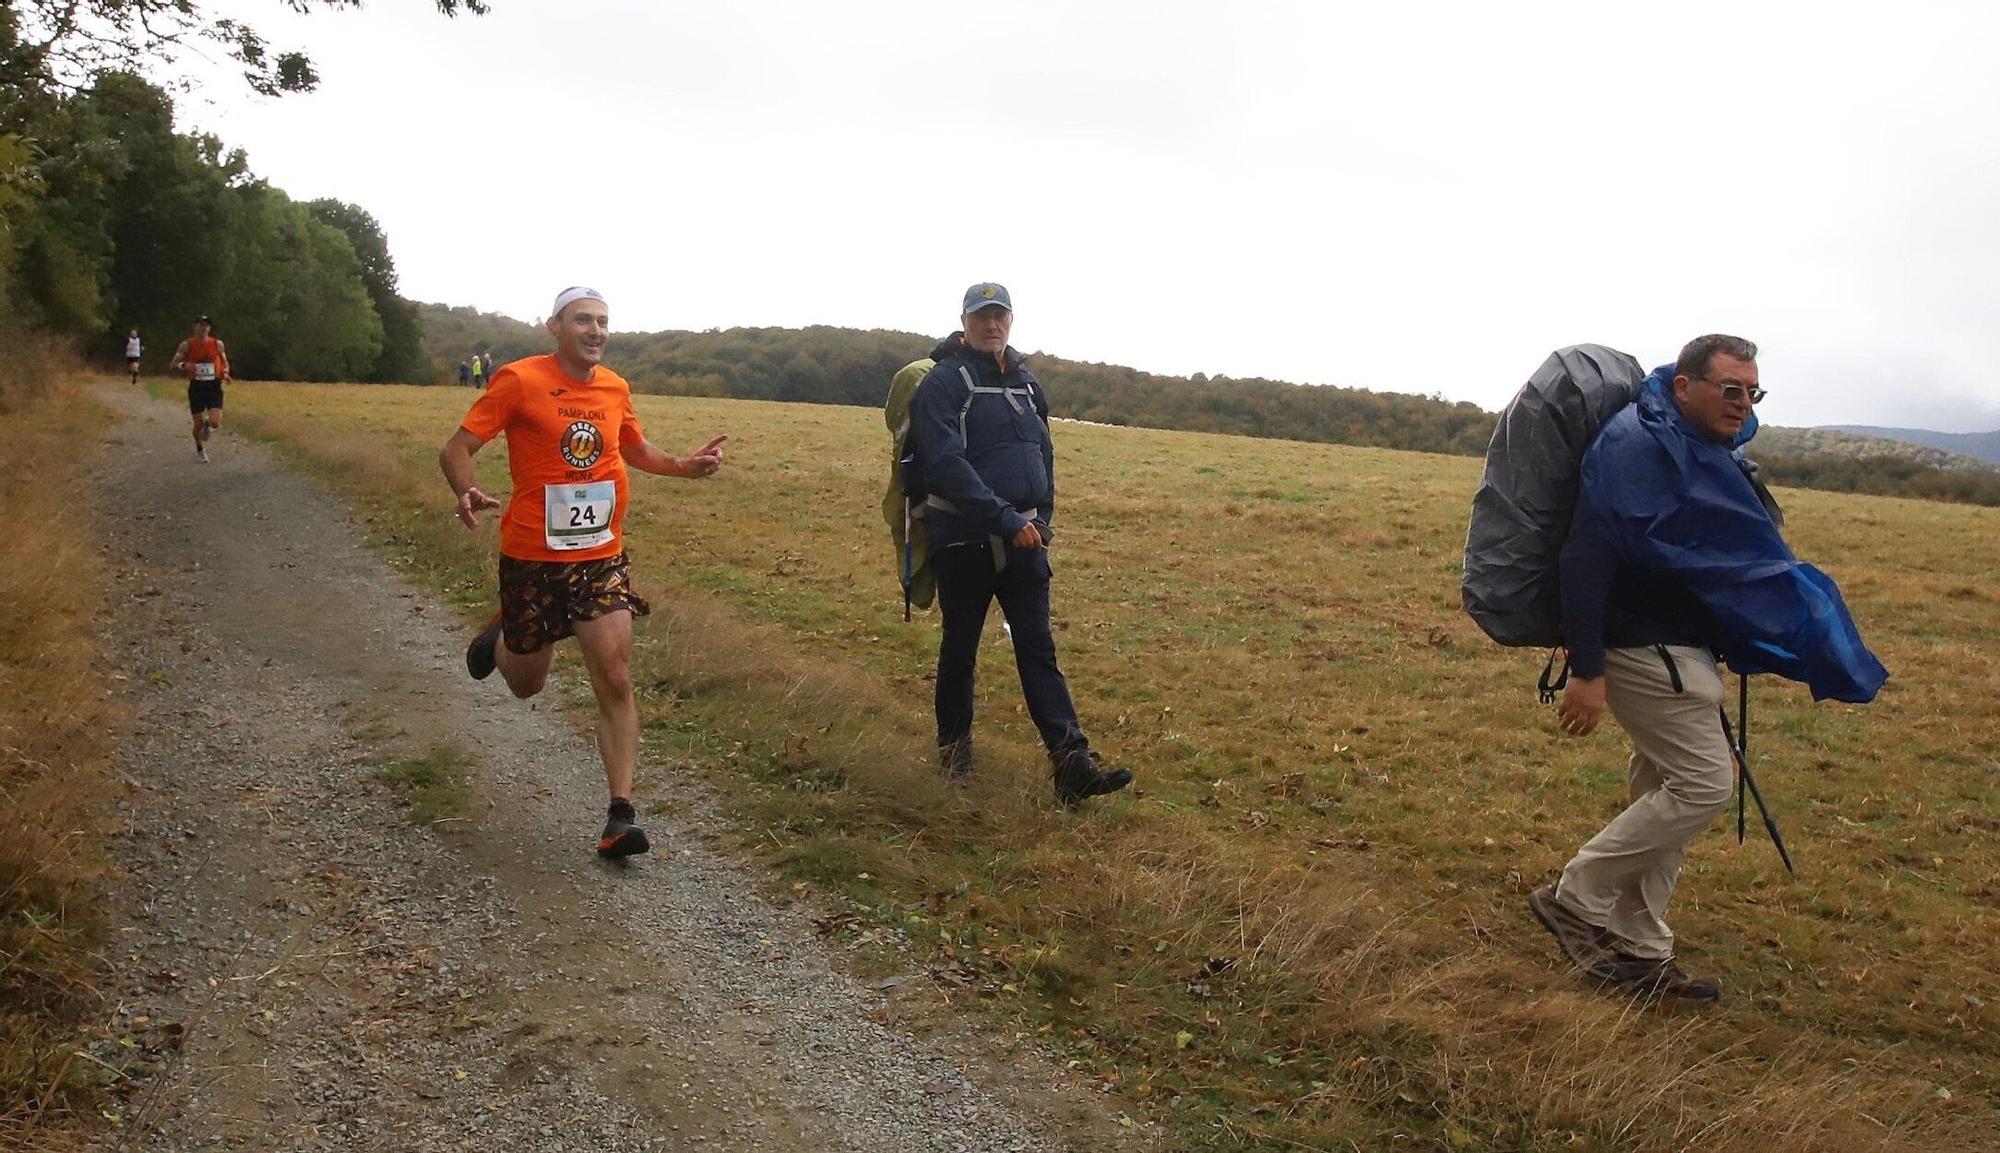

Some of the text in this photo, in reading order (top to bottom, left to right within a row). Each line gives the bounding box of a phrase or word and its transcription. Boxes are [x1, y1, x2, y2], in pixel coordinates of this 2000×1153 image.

[558, 408, 607, 420] PAMPLONA
[571, 422, 597, 434] BEER
[562, 446, 600, 468] RUNNERS
[570, 505, 596, 527] 24
